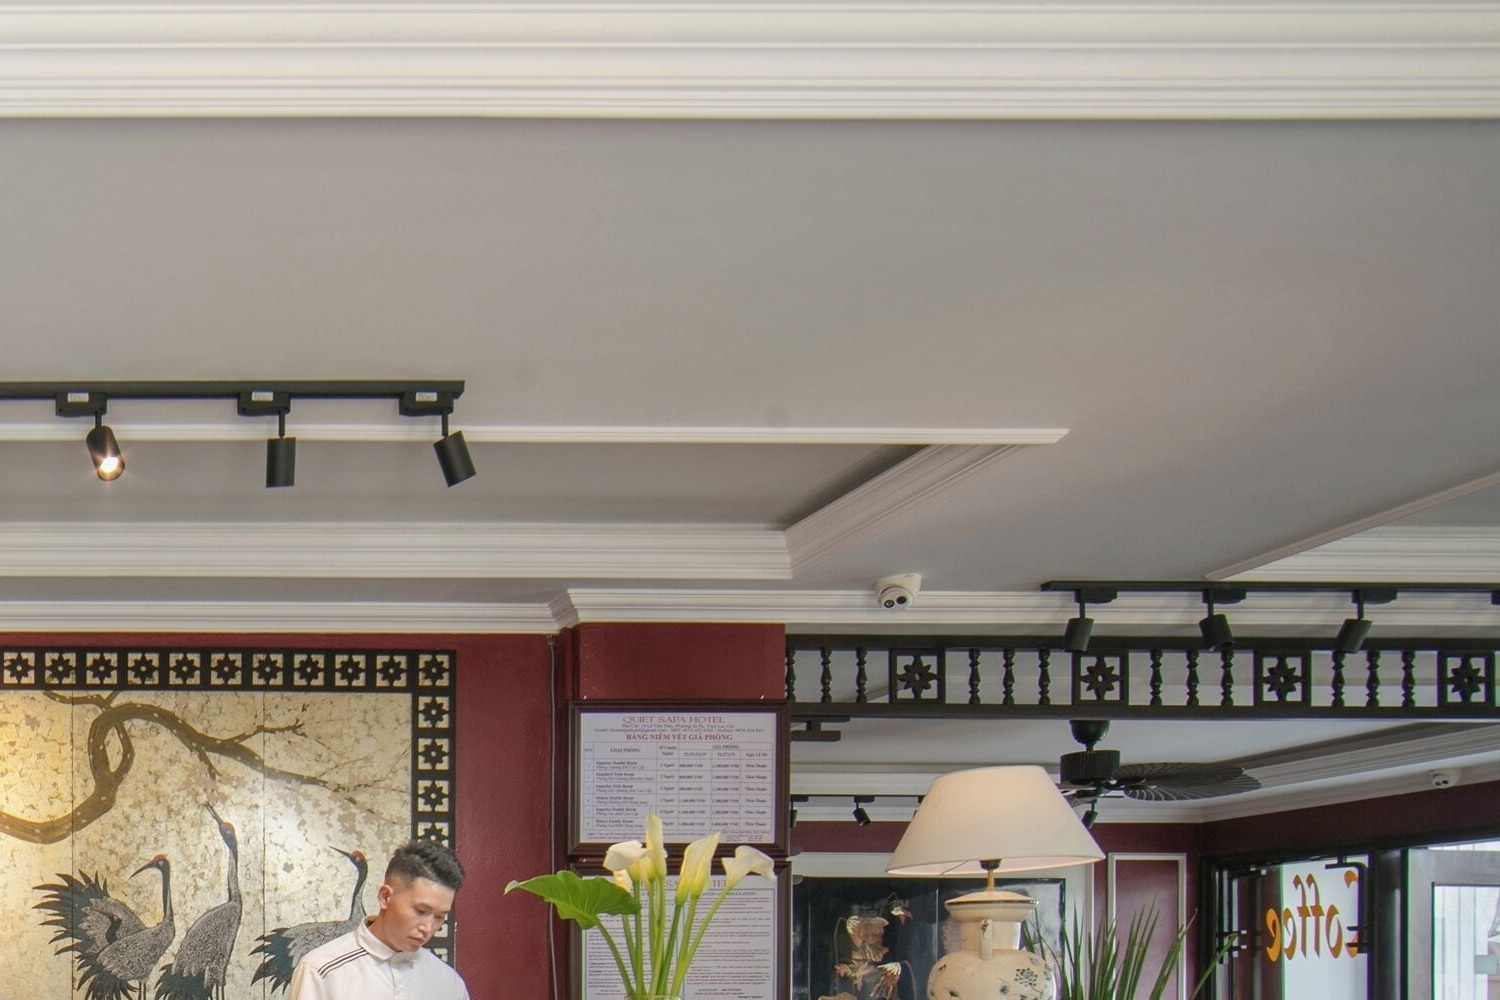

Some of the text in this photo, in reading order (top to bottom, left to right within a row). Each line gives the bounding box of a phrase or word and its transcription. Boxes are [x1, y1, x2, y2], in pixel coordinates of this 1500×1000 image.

[622, 715, 725, 724] QUIET SAPA HOTEL
